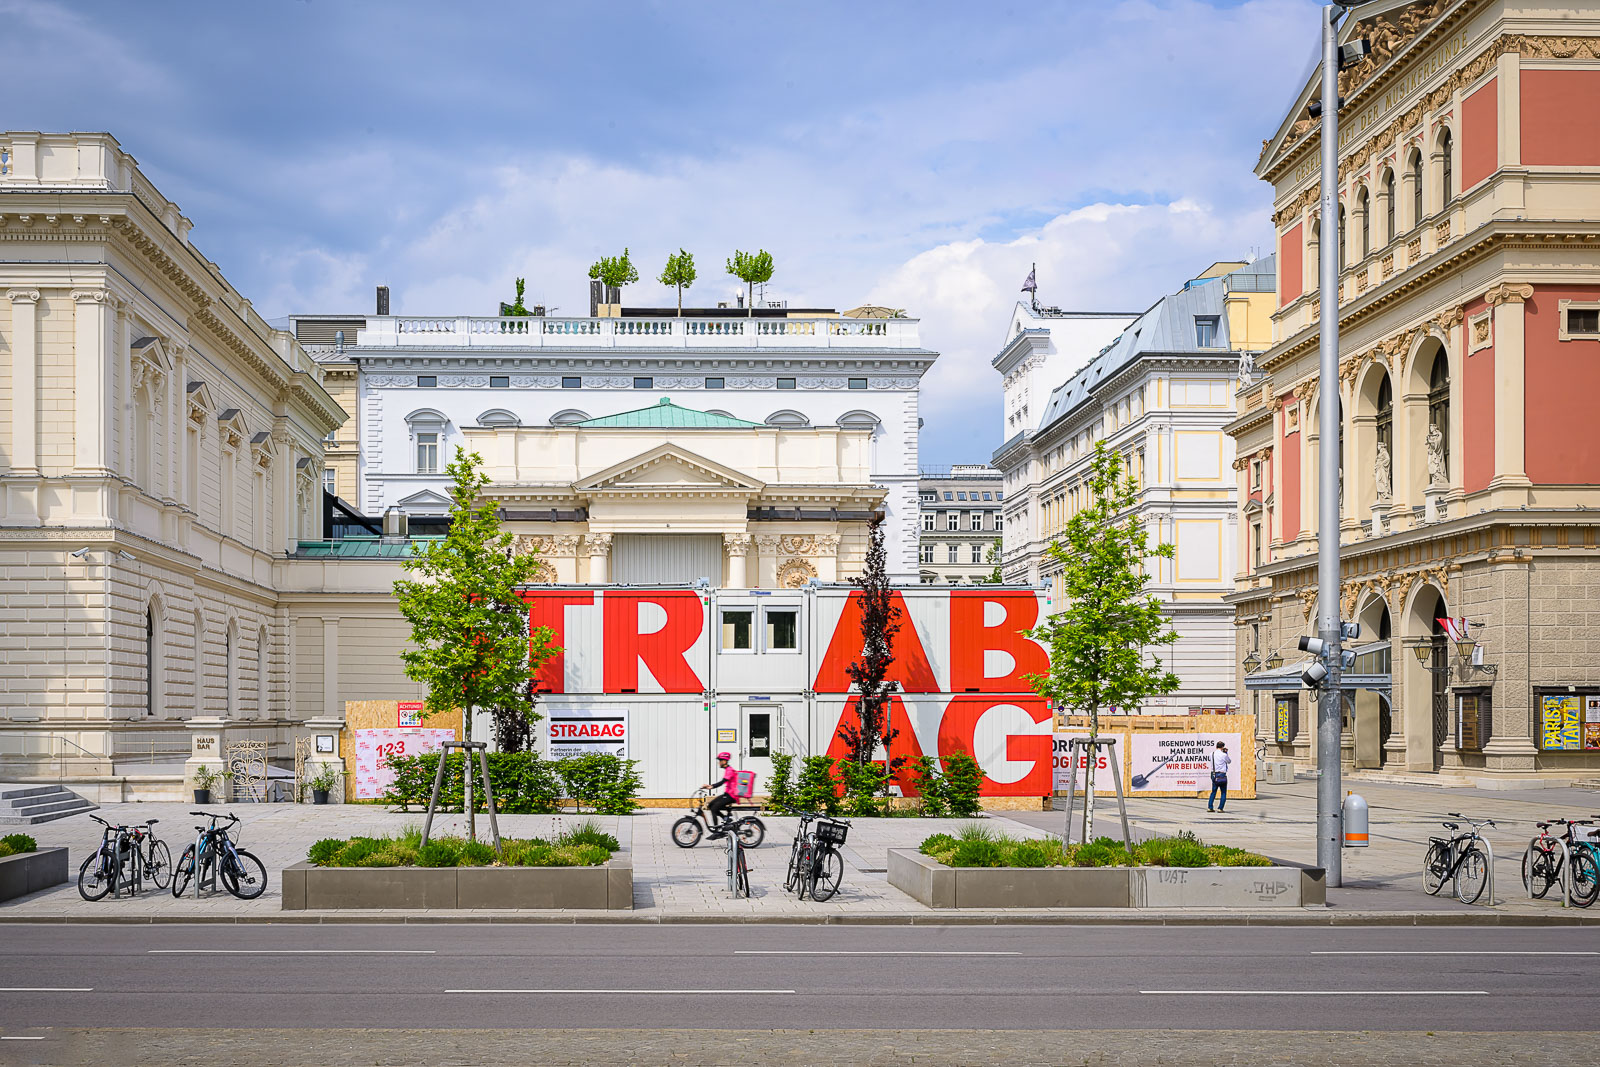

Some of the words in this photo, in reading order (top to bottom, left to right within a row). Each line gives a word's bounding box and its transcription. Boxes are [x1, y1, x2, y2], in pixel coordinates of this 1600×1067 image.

[1296, 123, 1355, 182] GESELAFT
[1361, 104, 1379, 131] DER
[1385, 30, 1468, 111] MUSIKFREUNDE
[550, 724, 625, 737] STRABAG
